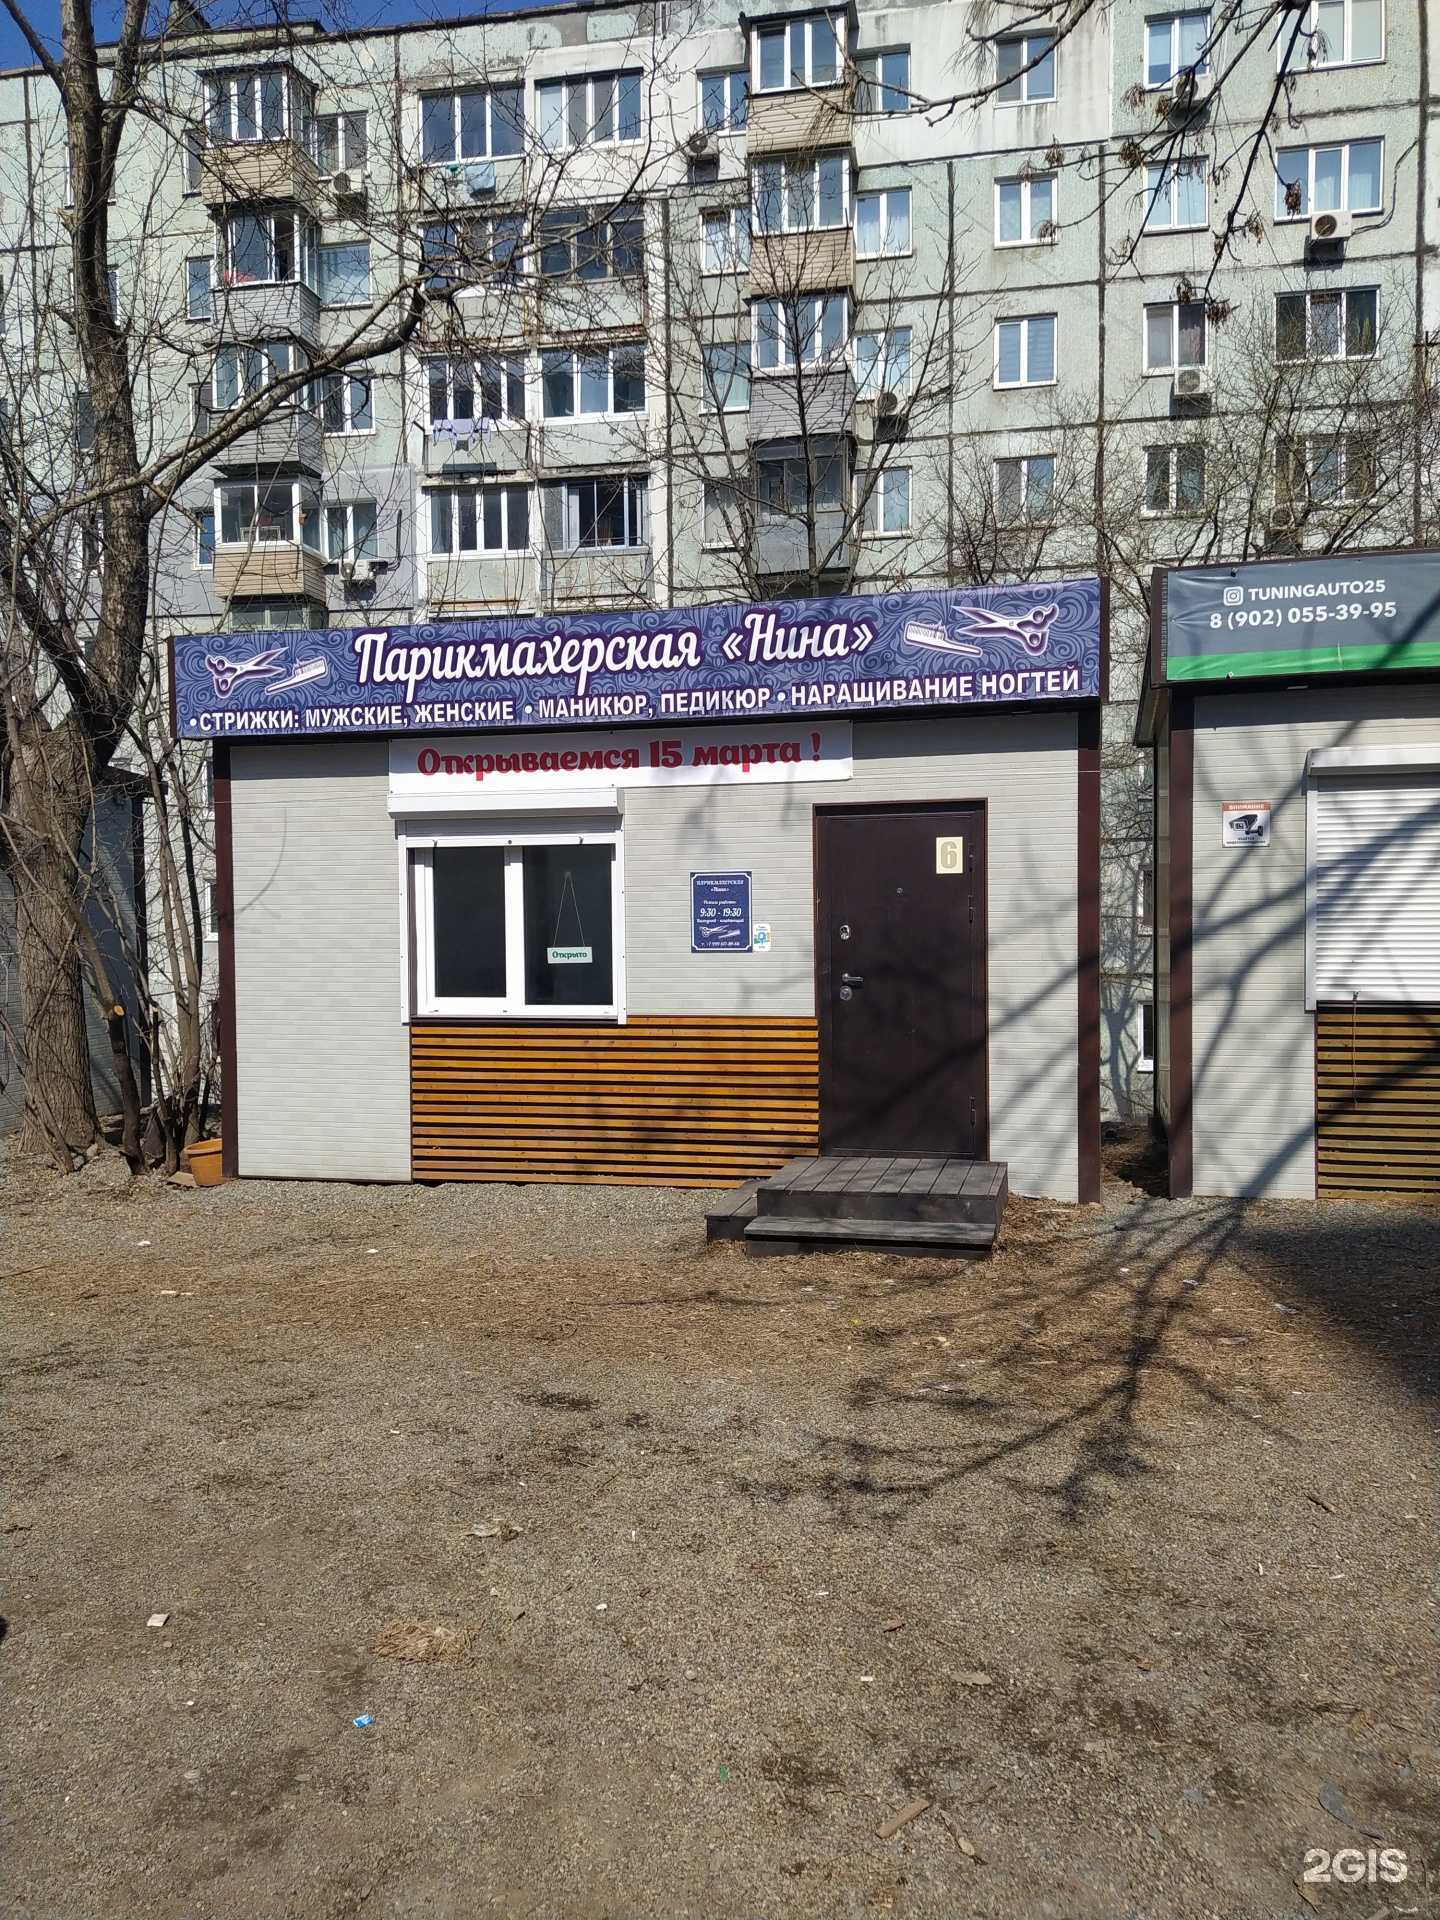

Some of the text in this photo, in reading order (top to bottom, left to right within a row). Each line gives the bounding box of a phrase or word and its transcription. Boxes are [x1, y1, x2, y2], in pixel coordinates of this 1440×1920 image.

[1247, 579, 1386, 601] TUNINGAUTO25
[1209, 602, 1397, 630] 8 (902) 055-39-95
[354, 612, 874, 704] Парикмахерская «Нина»
[199, 663, 1080, 731] СТРИЖКИ: МУЖСКИЕ, ЖЕНСКИЕ МАНИКЮР, ПЕДИКЮР НАРАЩИВАНИЕ НОГТЕЙ
[417, 746, 640, 781] Открываемся
[649, 740, 683, 768] 15
[693, 740, 801, 773] марта
[940, 841, 958, 869] 6
[700, 907, 717, 917] 9:30
[722, 907, 742, 917] 19:30
[552, 950, 588, 960] Открыто
